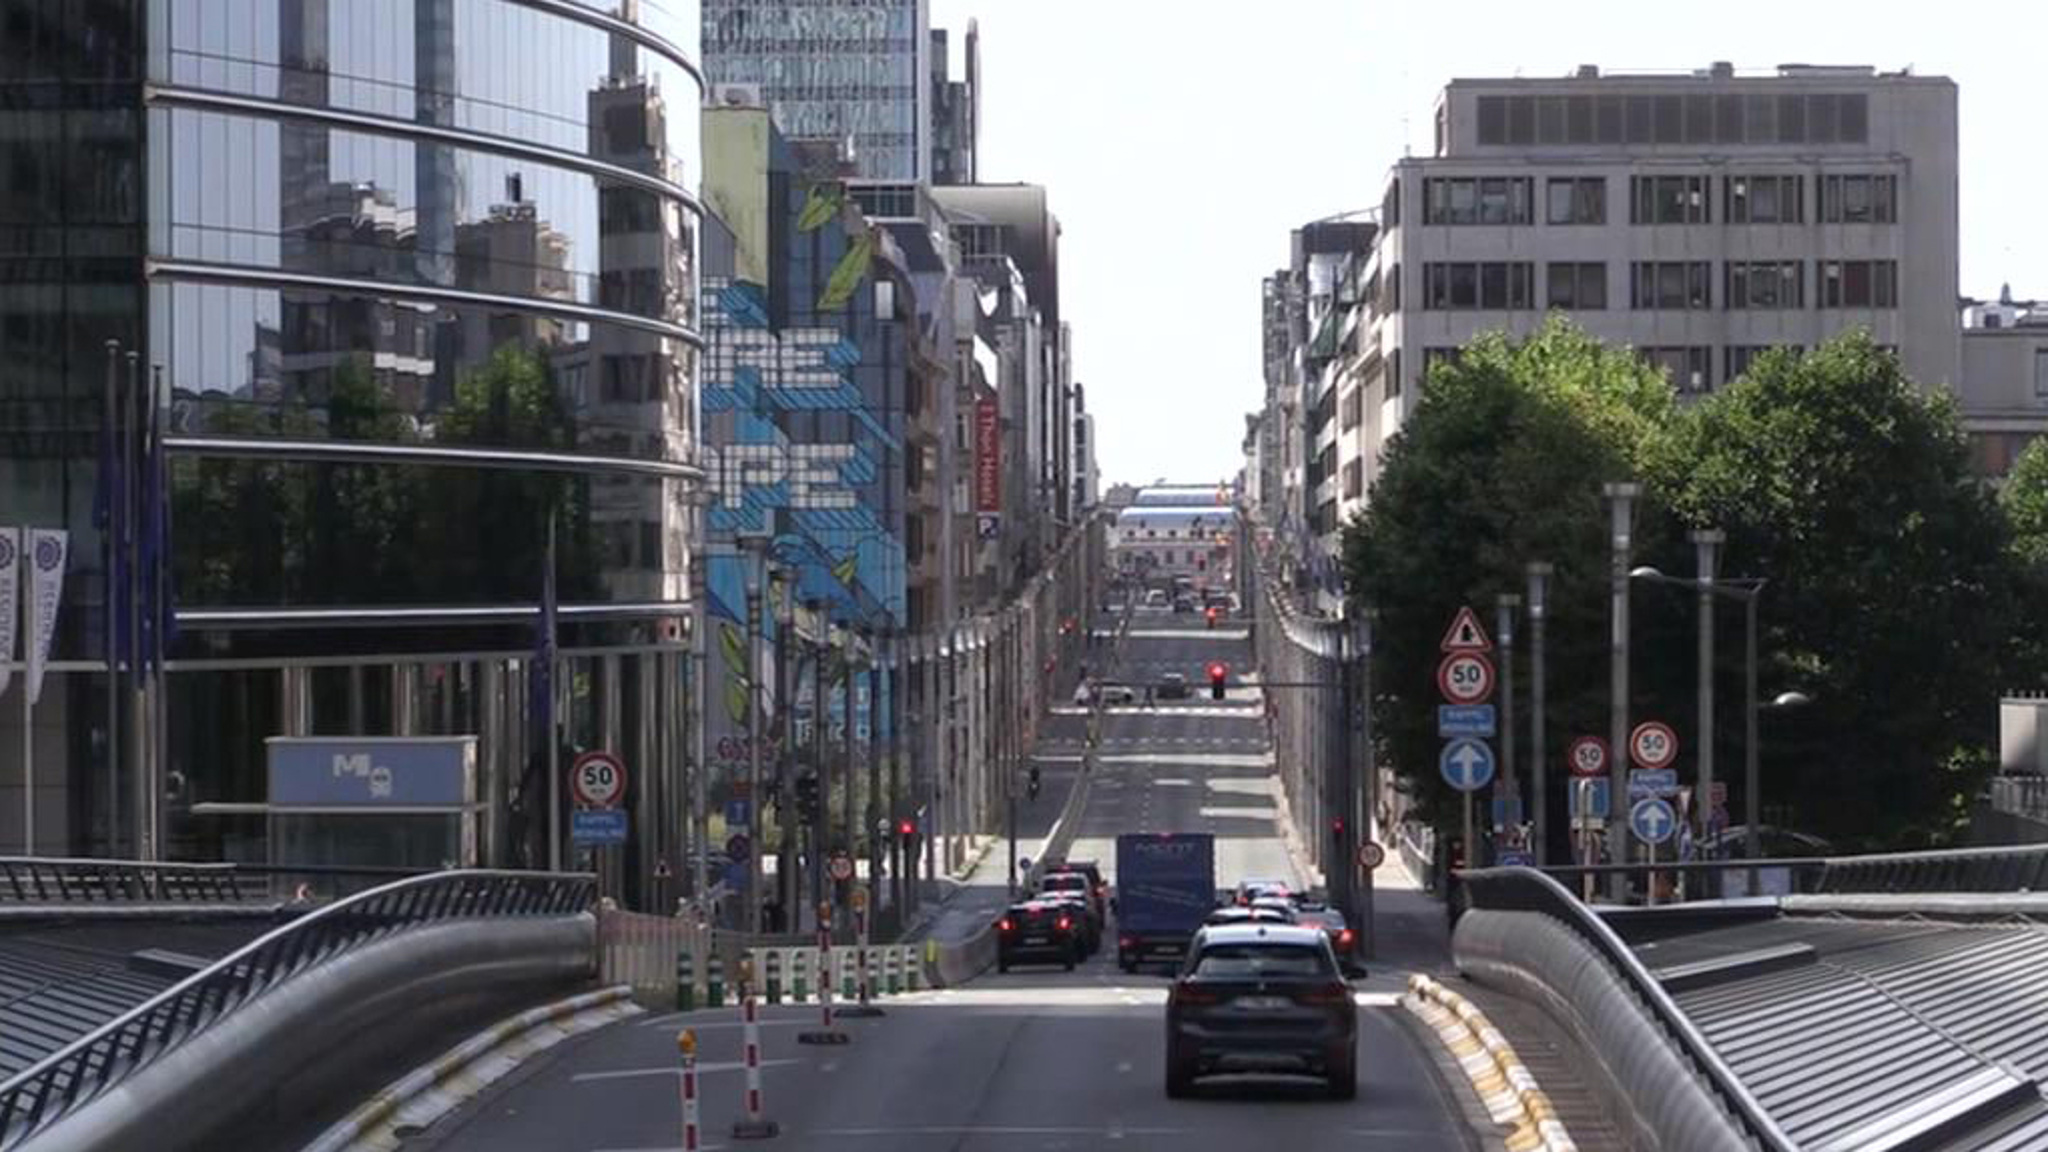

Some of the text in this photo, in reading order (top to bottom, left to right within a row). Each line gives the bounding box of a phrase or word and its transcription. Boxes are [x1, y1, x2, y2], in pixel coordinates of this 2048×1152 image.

[981, 415, 995, 505] Thon Hotels
[1453, 664, 1481, 683] 50
[1642, 735, 1666, 750] 50
[1579, 748, 1601, 762] 50
[584, 766, 612, 785] 50
